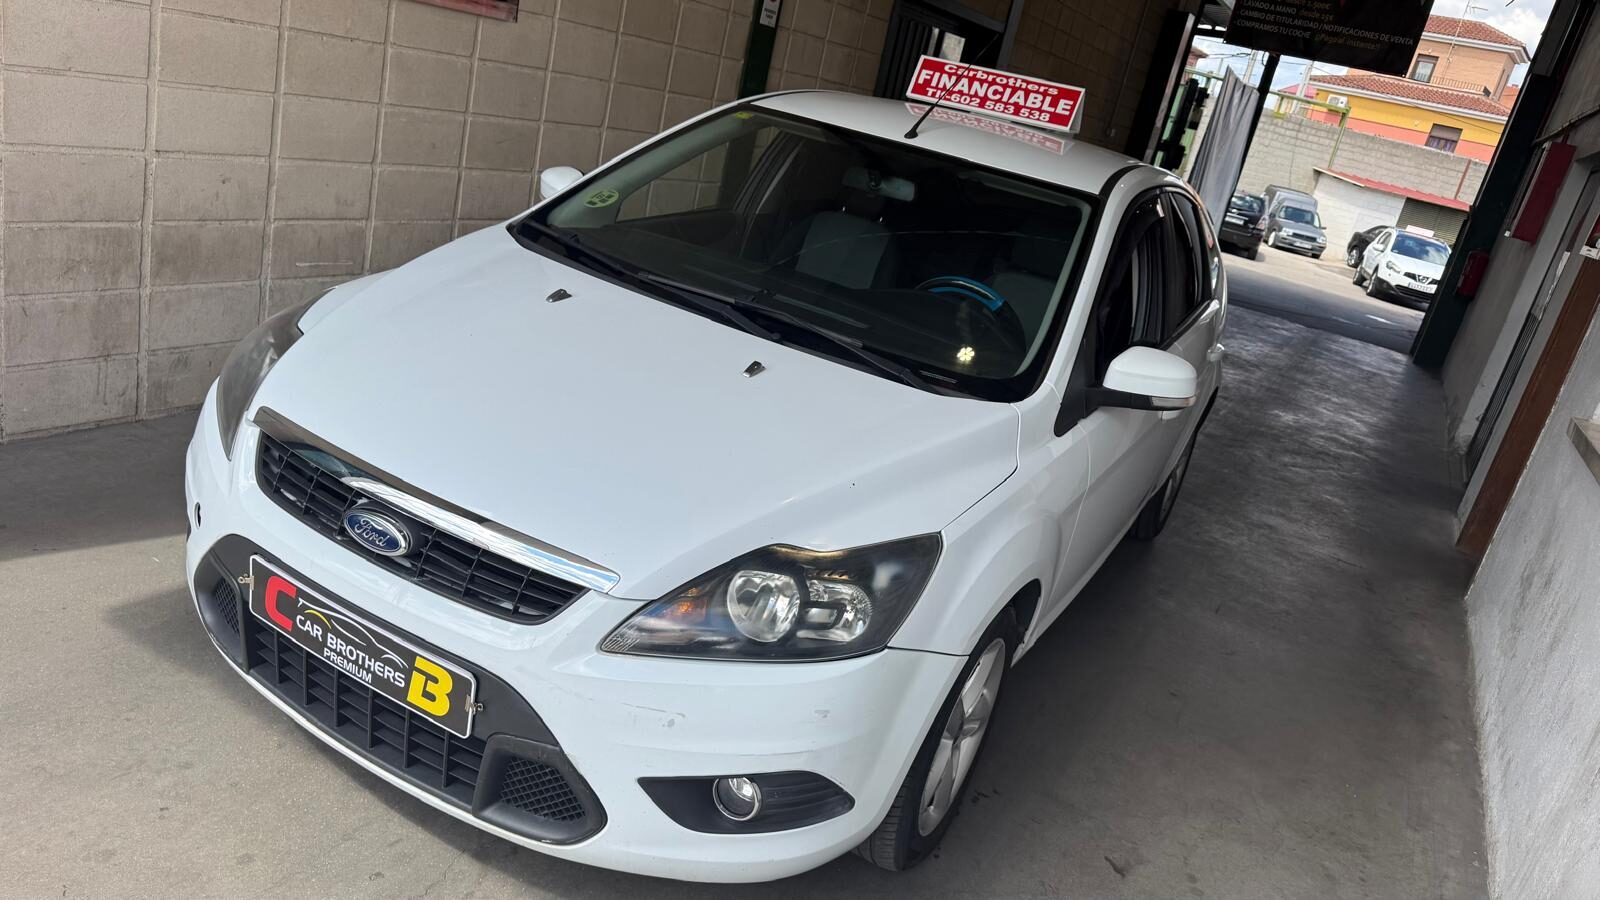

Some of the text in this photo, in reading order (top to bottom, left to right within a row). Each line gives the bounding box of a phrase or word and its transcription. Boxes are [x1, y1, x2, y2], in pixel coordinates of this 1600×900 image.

[1275, 5, 1296, 14] MANO
[1236, 19, 1279, 33] COMPRAMOS
[1288, 28, 1310, 38] COCHE
[1239, 8, 1265, 19] CAMBIO
[1265, 13, 1275, 21] DE
[1275, 15, 1318, 29] TITULARIDAD
[1321, 23, 1379, 39] NOTIFICACIONES
[1379, 33, 1389, 41] DE
[1388, 34, 1413, 45] VENTA
[917, 69, 1074, 115] FINANCIABLE
[944, 64, 1059, 95] Carbrothers
[984, 101, 1014, 114] 583
[1019, 108, 1050, 122] 538
[353, 517, 390, 548] Ford
[264, 575, 297, 632] C
[296, 614, 406, 688] CAR BROTHERS
[323, 648, 372, 684] PREMIUM
